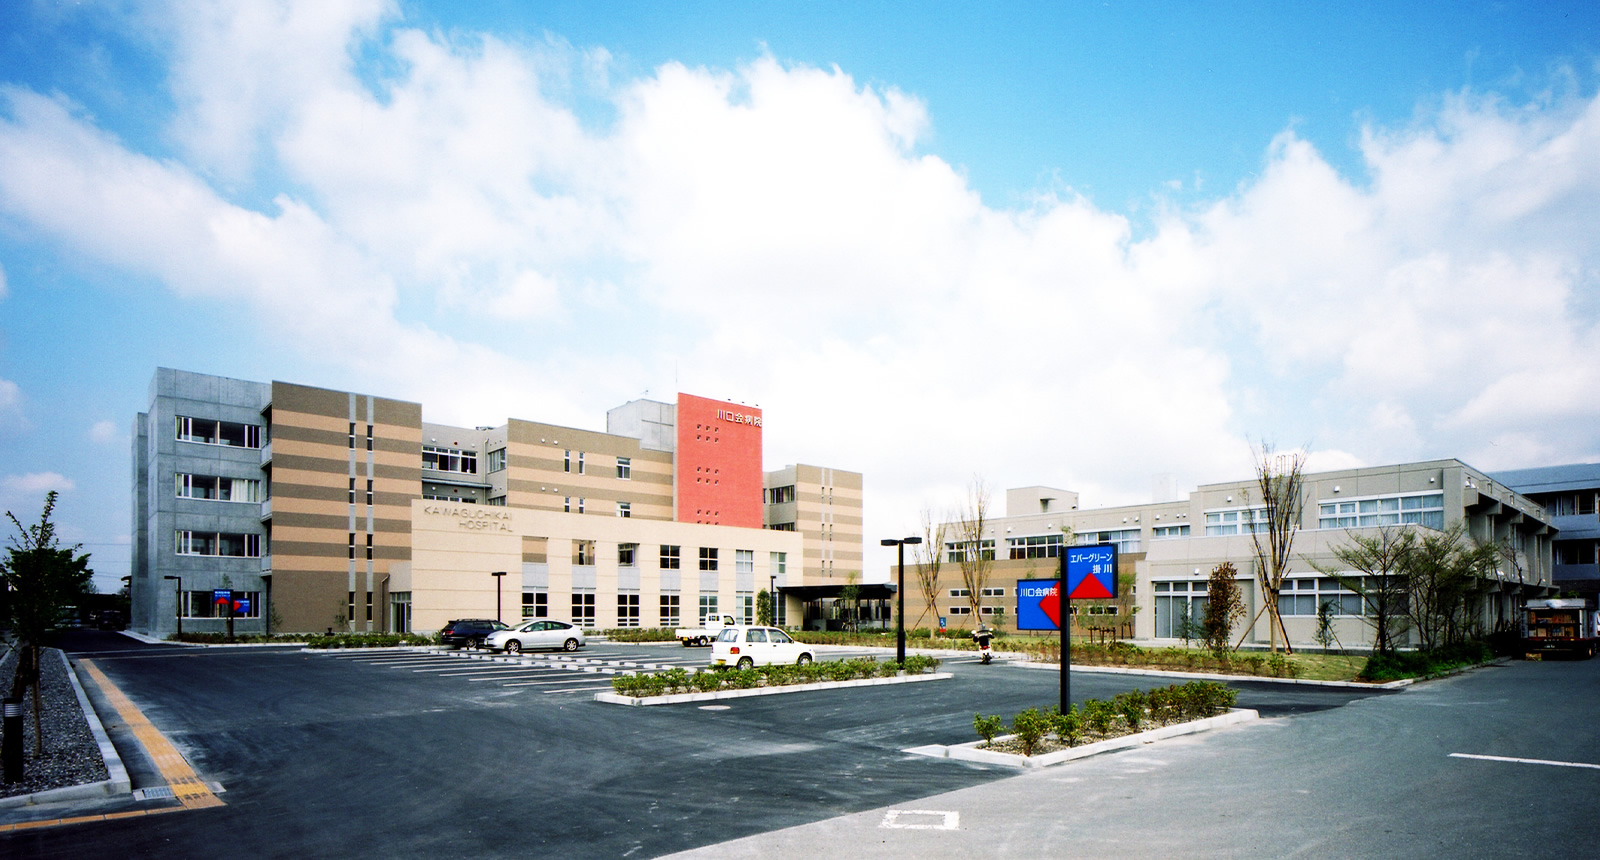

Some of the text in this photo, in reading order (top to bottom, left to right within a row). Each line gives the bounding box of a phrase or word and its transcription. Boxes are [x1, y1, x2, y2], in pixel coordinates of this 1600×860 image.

[716, 409, 762, 427] 川口会病院
[459, 520, 513, 532] HOSPITAL
[1070, 553, 1113, 563] エバーグリーン
[1020, 587, 1058, 597] 川口会病院
